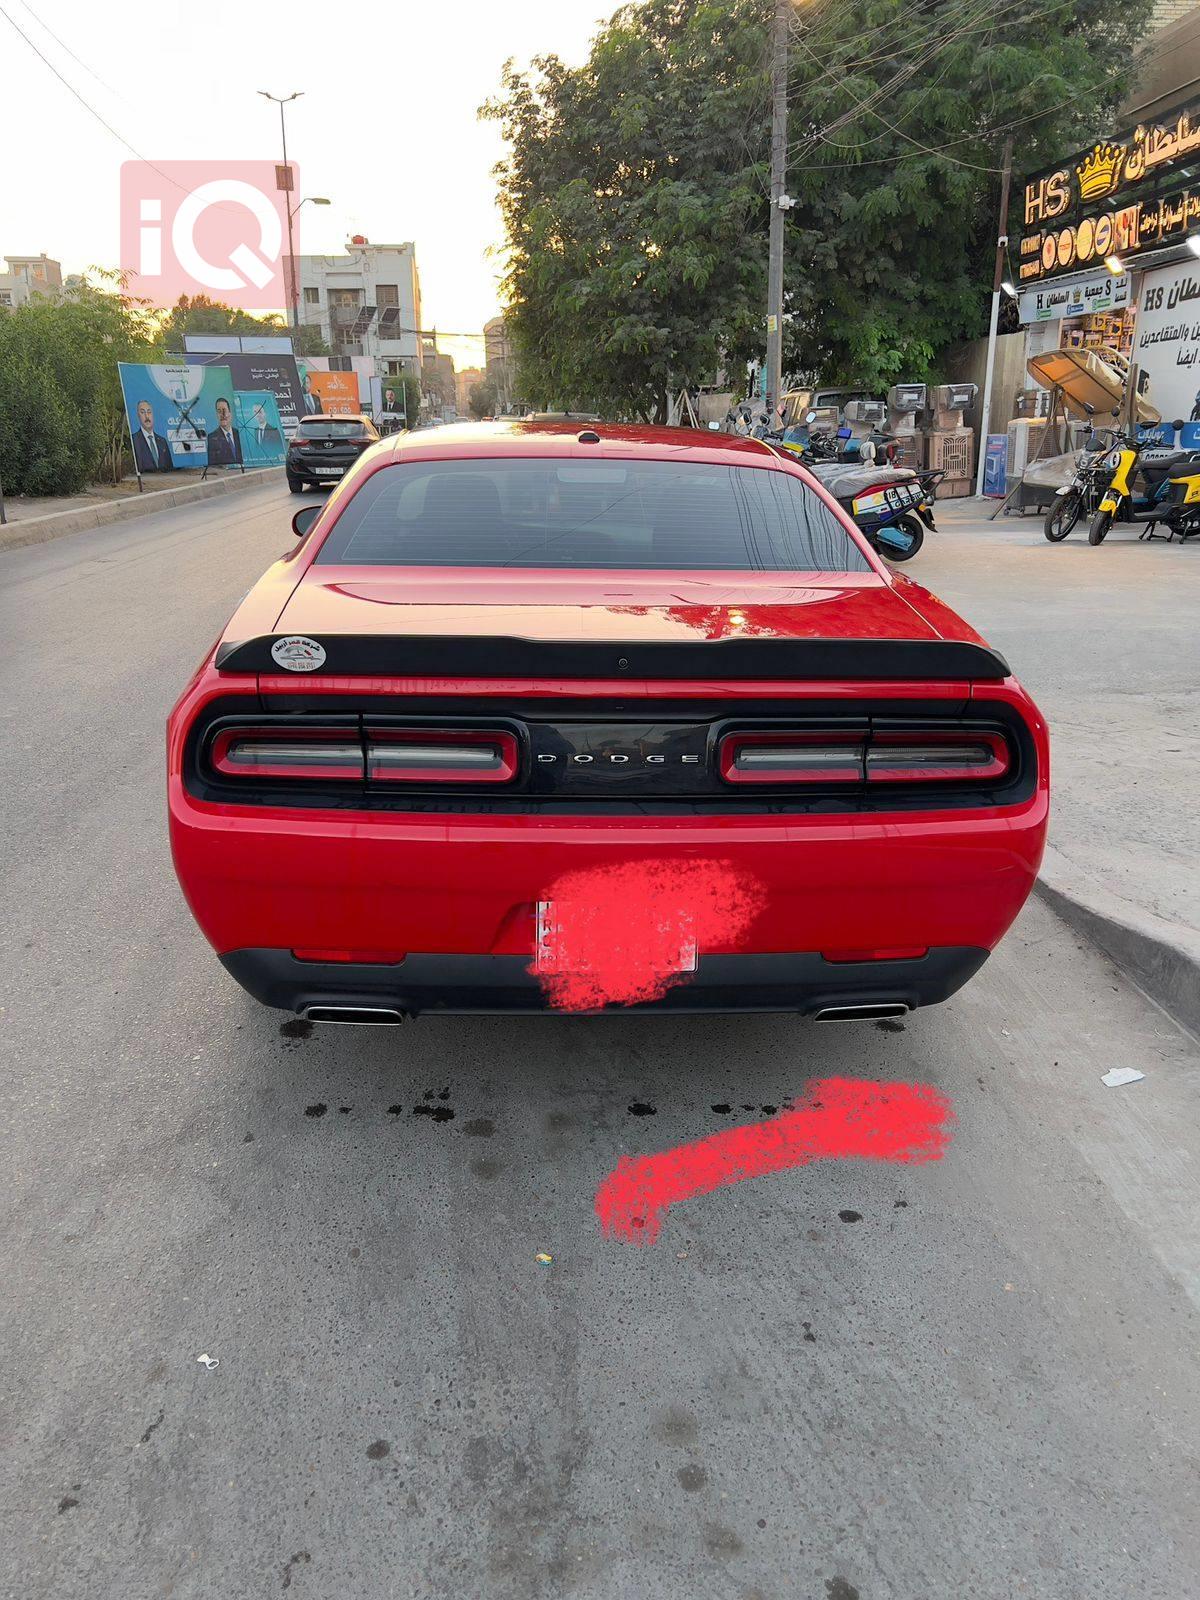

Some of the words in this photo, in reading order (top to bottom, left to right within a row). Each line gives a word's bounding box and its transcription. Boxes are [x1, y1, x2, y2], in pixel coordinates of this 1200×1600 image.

[1025, 171, 1069, 224] HS
[1084, 286, 1103, 300] جمعية
[1105, 279, 1112, 296] S
[1036, 294, 1043, 309] H
[1046, 291, 1069, 308] السلطان
[1144, 287, 1164, 311] HS
[1140, 324, 1189, 348] والمتقاعدين
[302, 640, 320, 652] شركة
[538, 754, 699, 763] DODGE
